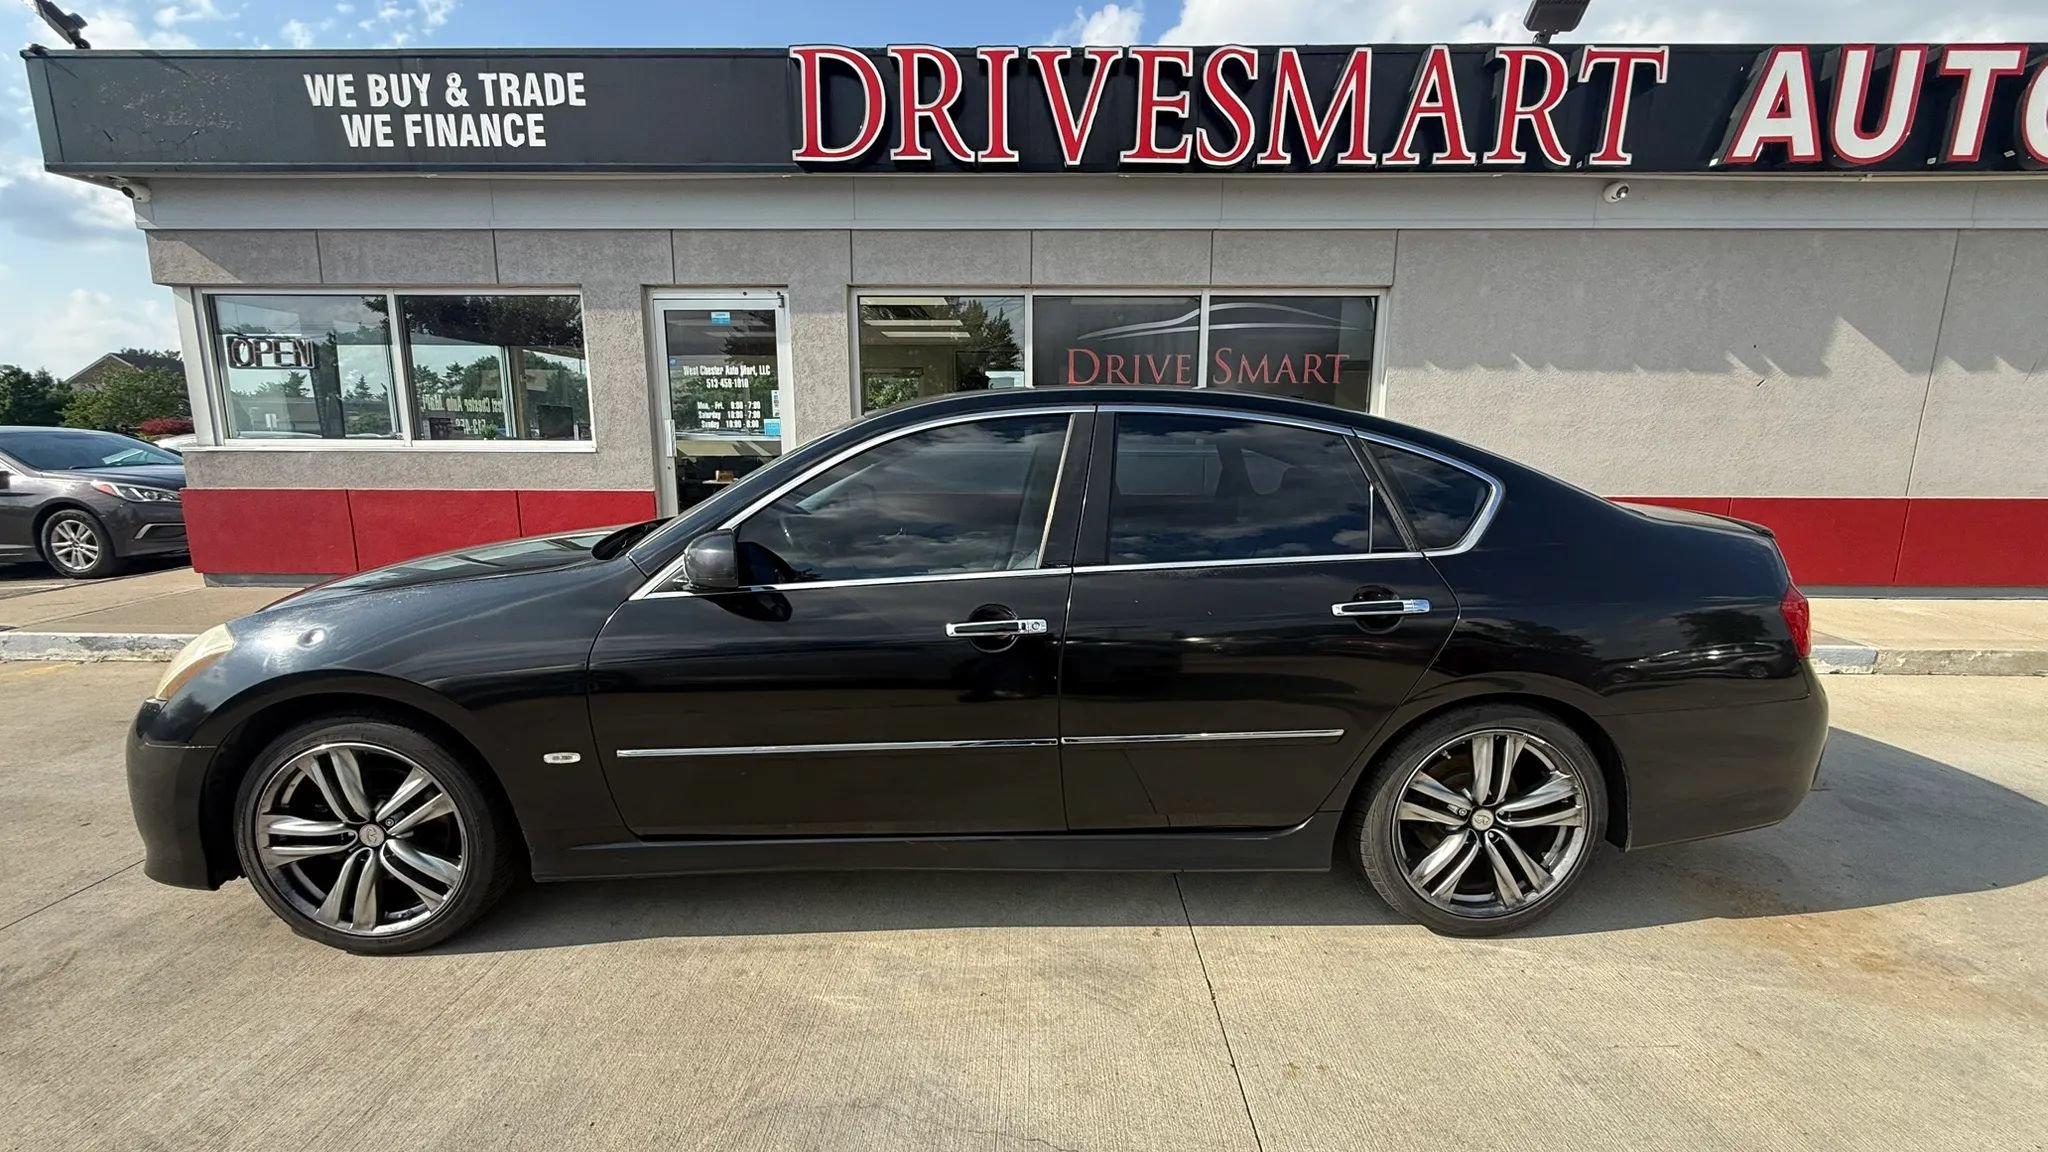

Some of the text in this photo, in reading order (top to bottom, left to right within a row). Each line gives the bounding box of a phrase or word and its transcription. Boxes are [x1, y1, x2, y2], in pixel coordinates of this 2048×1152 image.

[303, 72, 587, 107] WE BUY & TRADE
[789, 44, 1669, 166] DRIVESMART
[340, 113, 547, 148] WE FINANCE
[229, 338, 315, 368] OPEN
[1066, 347, 1350, 385] DRIVE SMART
[683, 365, 699, 376] West
[700, 365, 723, 376] Chester
[725, 365, 739, 376] Auto
[759, 365, 771, 376] LLC
[698, 411, 721, 420] Saturday
[701, 420, 720, 430] Sunday
